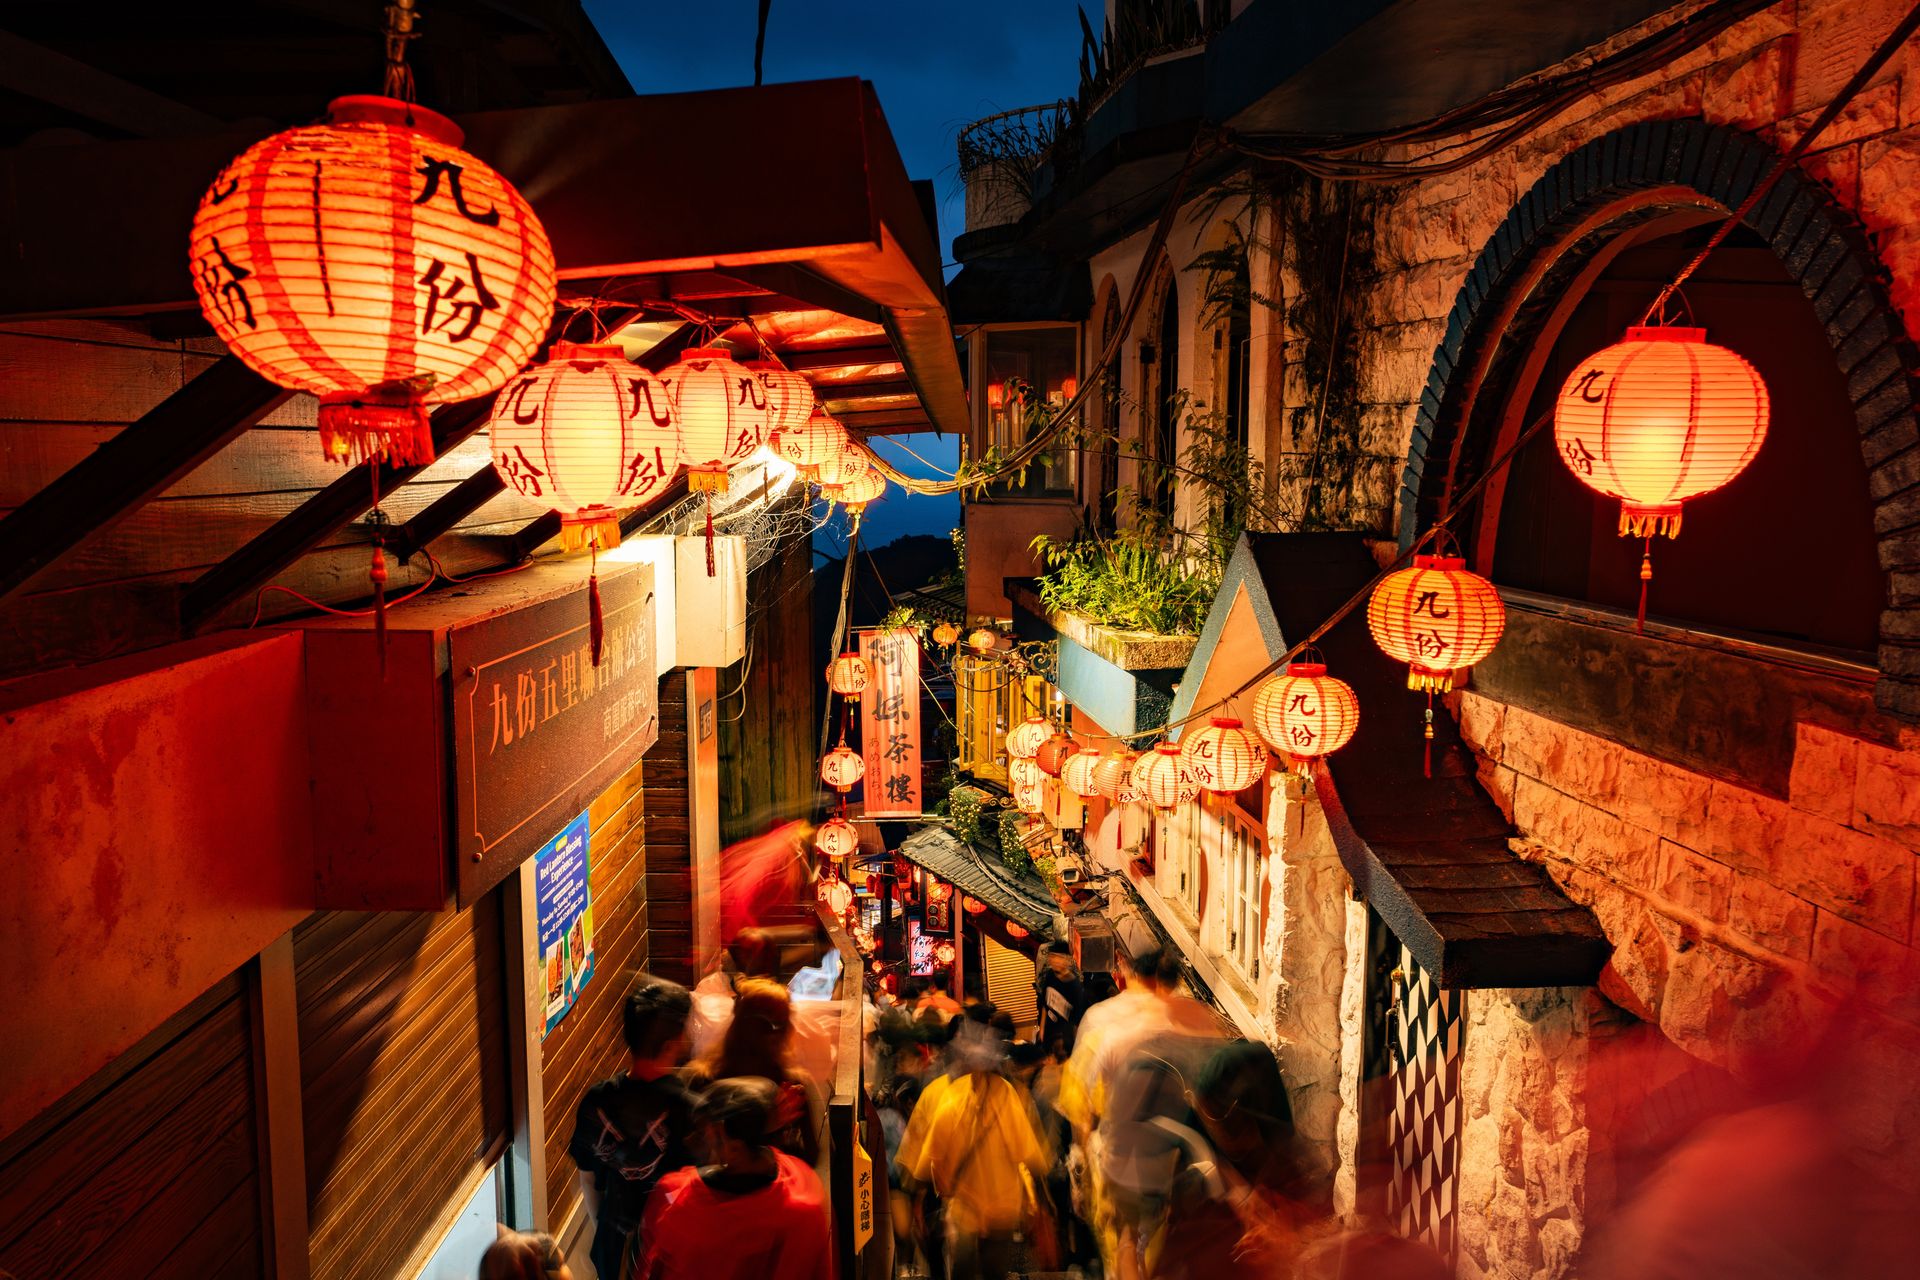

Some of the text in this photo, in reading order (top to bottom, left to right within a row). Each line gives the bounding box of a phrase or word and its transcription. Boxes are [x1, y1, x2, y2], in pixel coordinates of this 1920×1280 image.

[415, 155, 500, 343] 九份
[500, 376, 543, 498] 九份
[626, 378, 672, 498] 九份
[731, 377, 767, 458] 九份
[1566, 369, 1604, 476] 九份
[844, 444, 858, 477] 九份
[1413, 591, 1451, 660] 九份
[853, 664, 866, 689] 九份
[867, 638, 917, 804] 阿妹茶樓
[1289, 694, 1317, 747] 九份
[828, 761, 839, 784] 九份
[1180, 770, 1194, 802] 九份
[1193, 740, 1214, 784] 九份
[549, 851, 565, 872] Lantern
[828, 833, 838, 853] 九份
[551, 856, 573, 884] Experience
